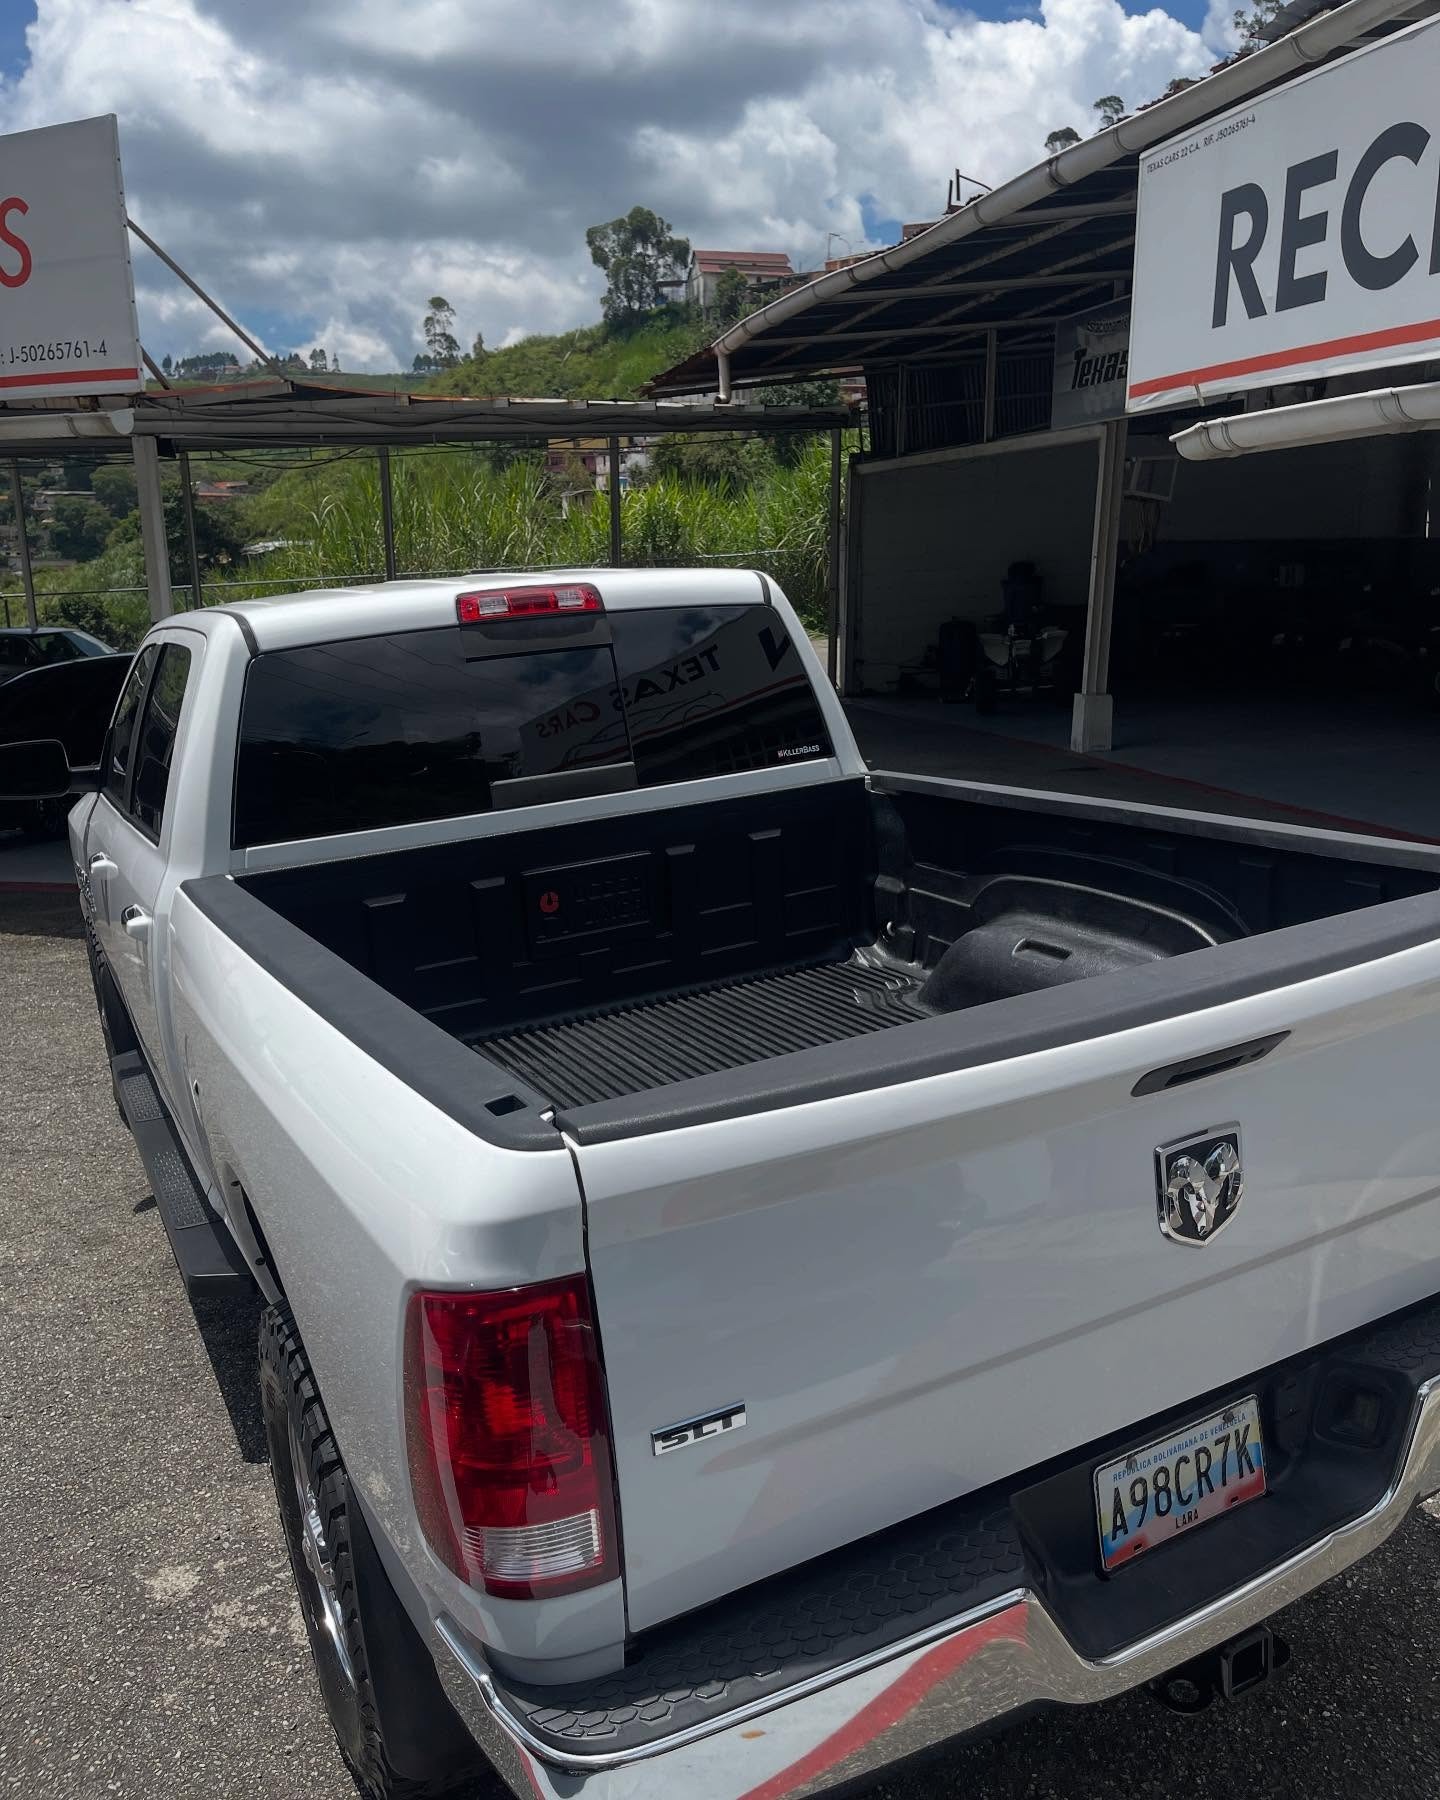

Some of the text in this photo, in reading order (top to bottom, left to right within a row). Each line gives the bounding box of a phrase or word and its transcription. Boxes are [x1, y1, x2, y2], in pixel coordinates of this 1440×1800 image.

[1147, 160, 1164, 174] TEXAS
[1164, 150, 1180, 166] CARS
[1180, 146, 1188, 158] 22
[1212, 121, 1440, 328] REC
[9, 339, 107, 364] J-50265761-4
[658, 1406, 743, 1451] SLT
[1153, 1436, 1198, 1463] BOLIVARIANA
[1199, 1430, 1209, 1442] DE
[1112, 1423, 1255, 1542] A98CR7K
[1175, 1508, 1199, 1530] LARA
